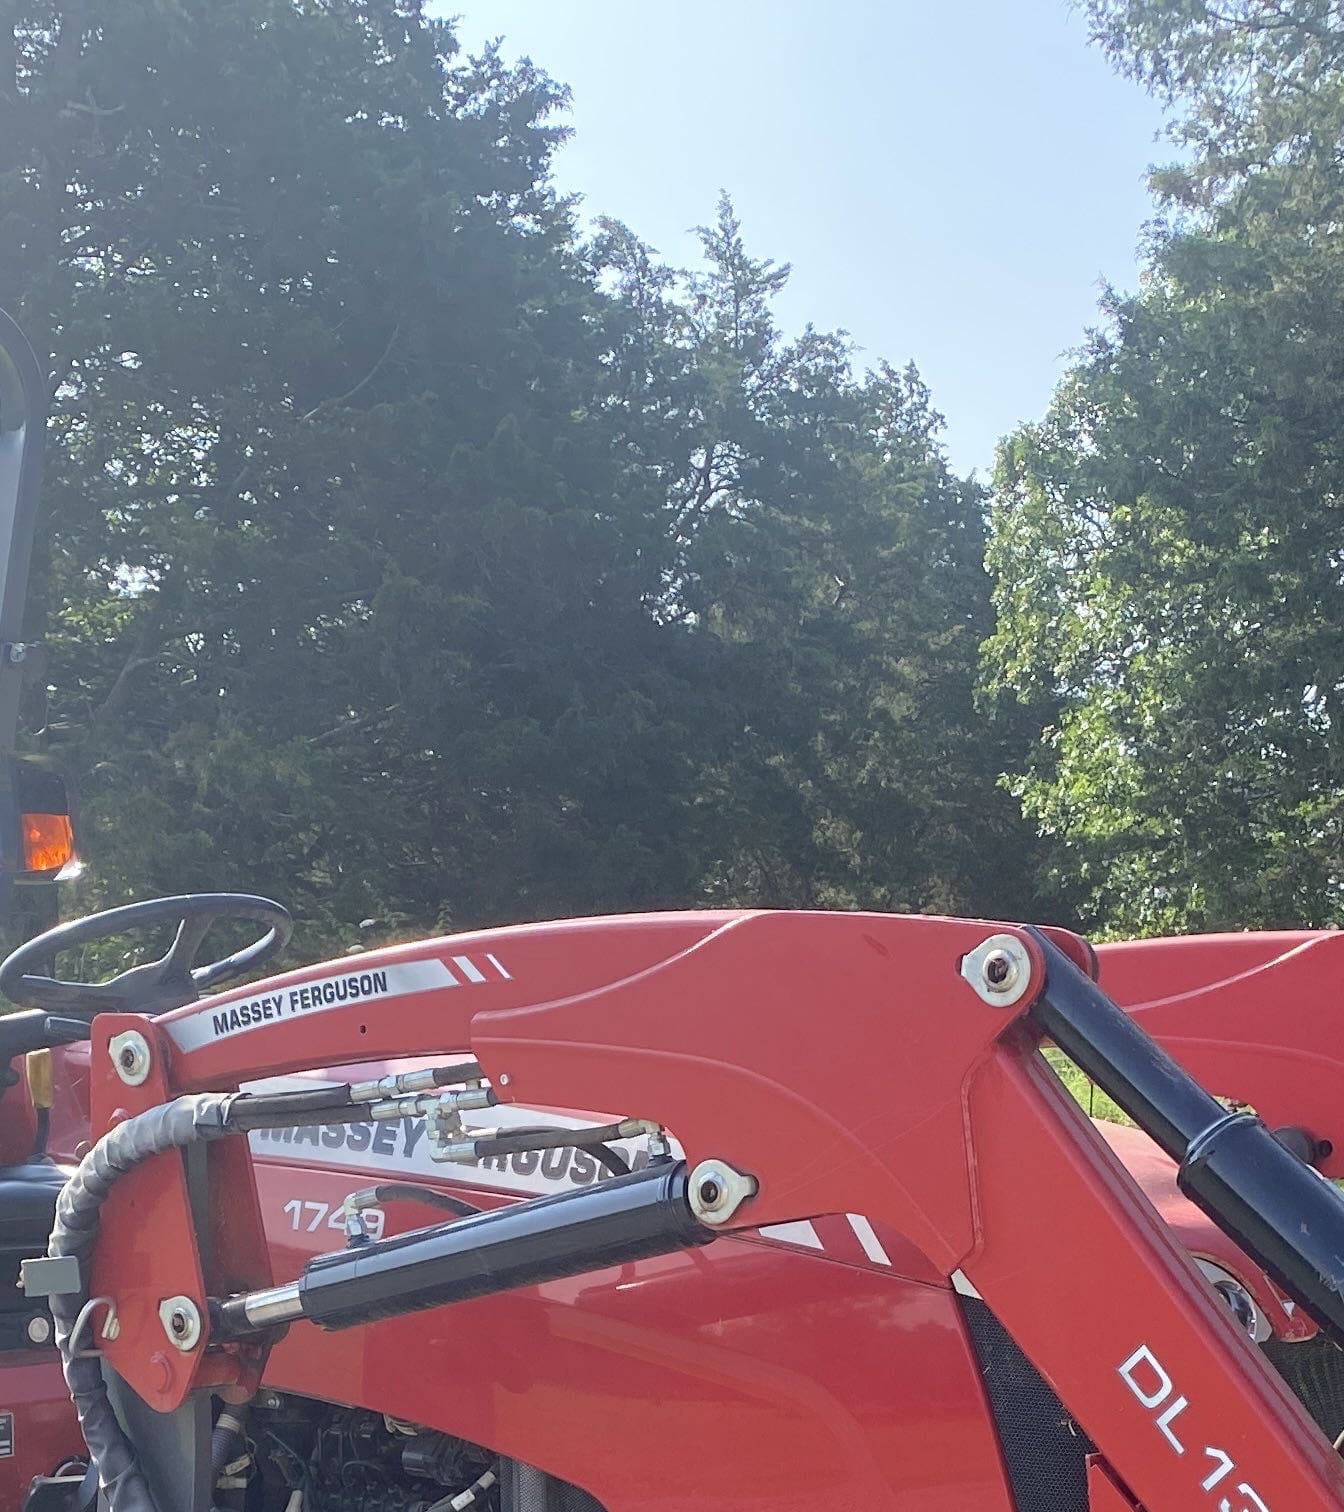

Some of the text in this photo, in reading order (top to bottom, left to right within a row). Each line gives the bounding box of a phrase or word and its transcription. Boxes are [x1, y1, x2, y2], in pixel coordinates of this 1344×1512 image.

[212, 971, 388, 1035] MASSEY FERGUSON
[283, 1199, 385, 1240] 1749
